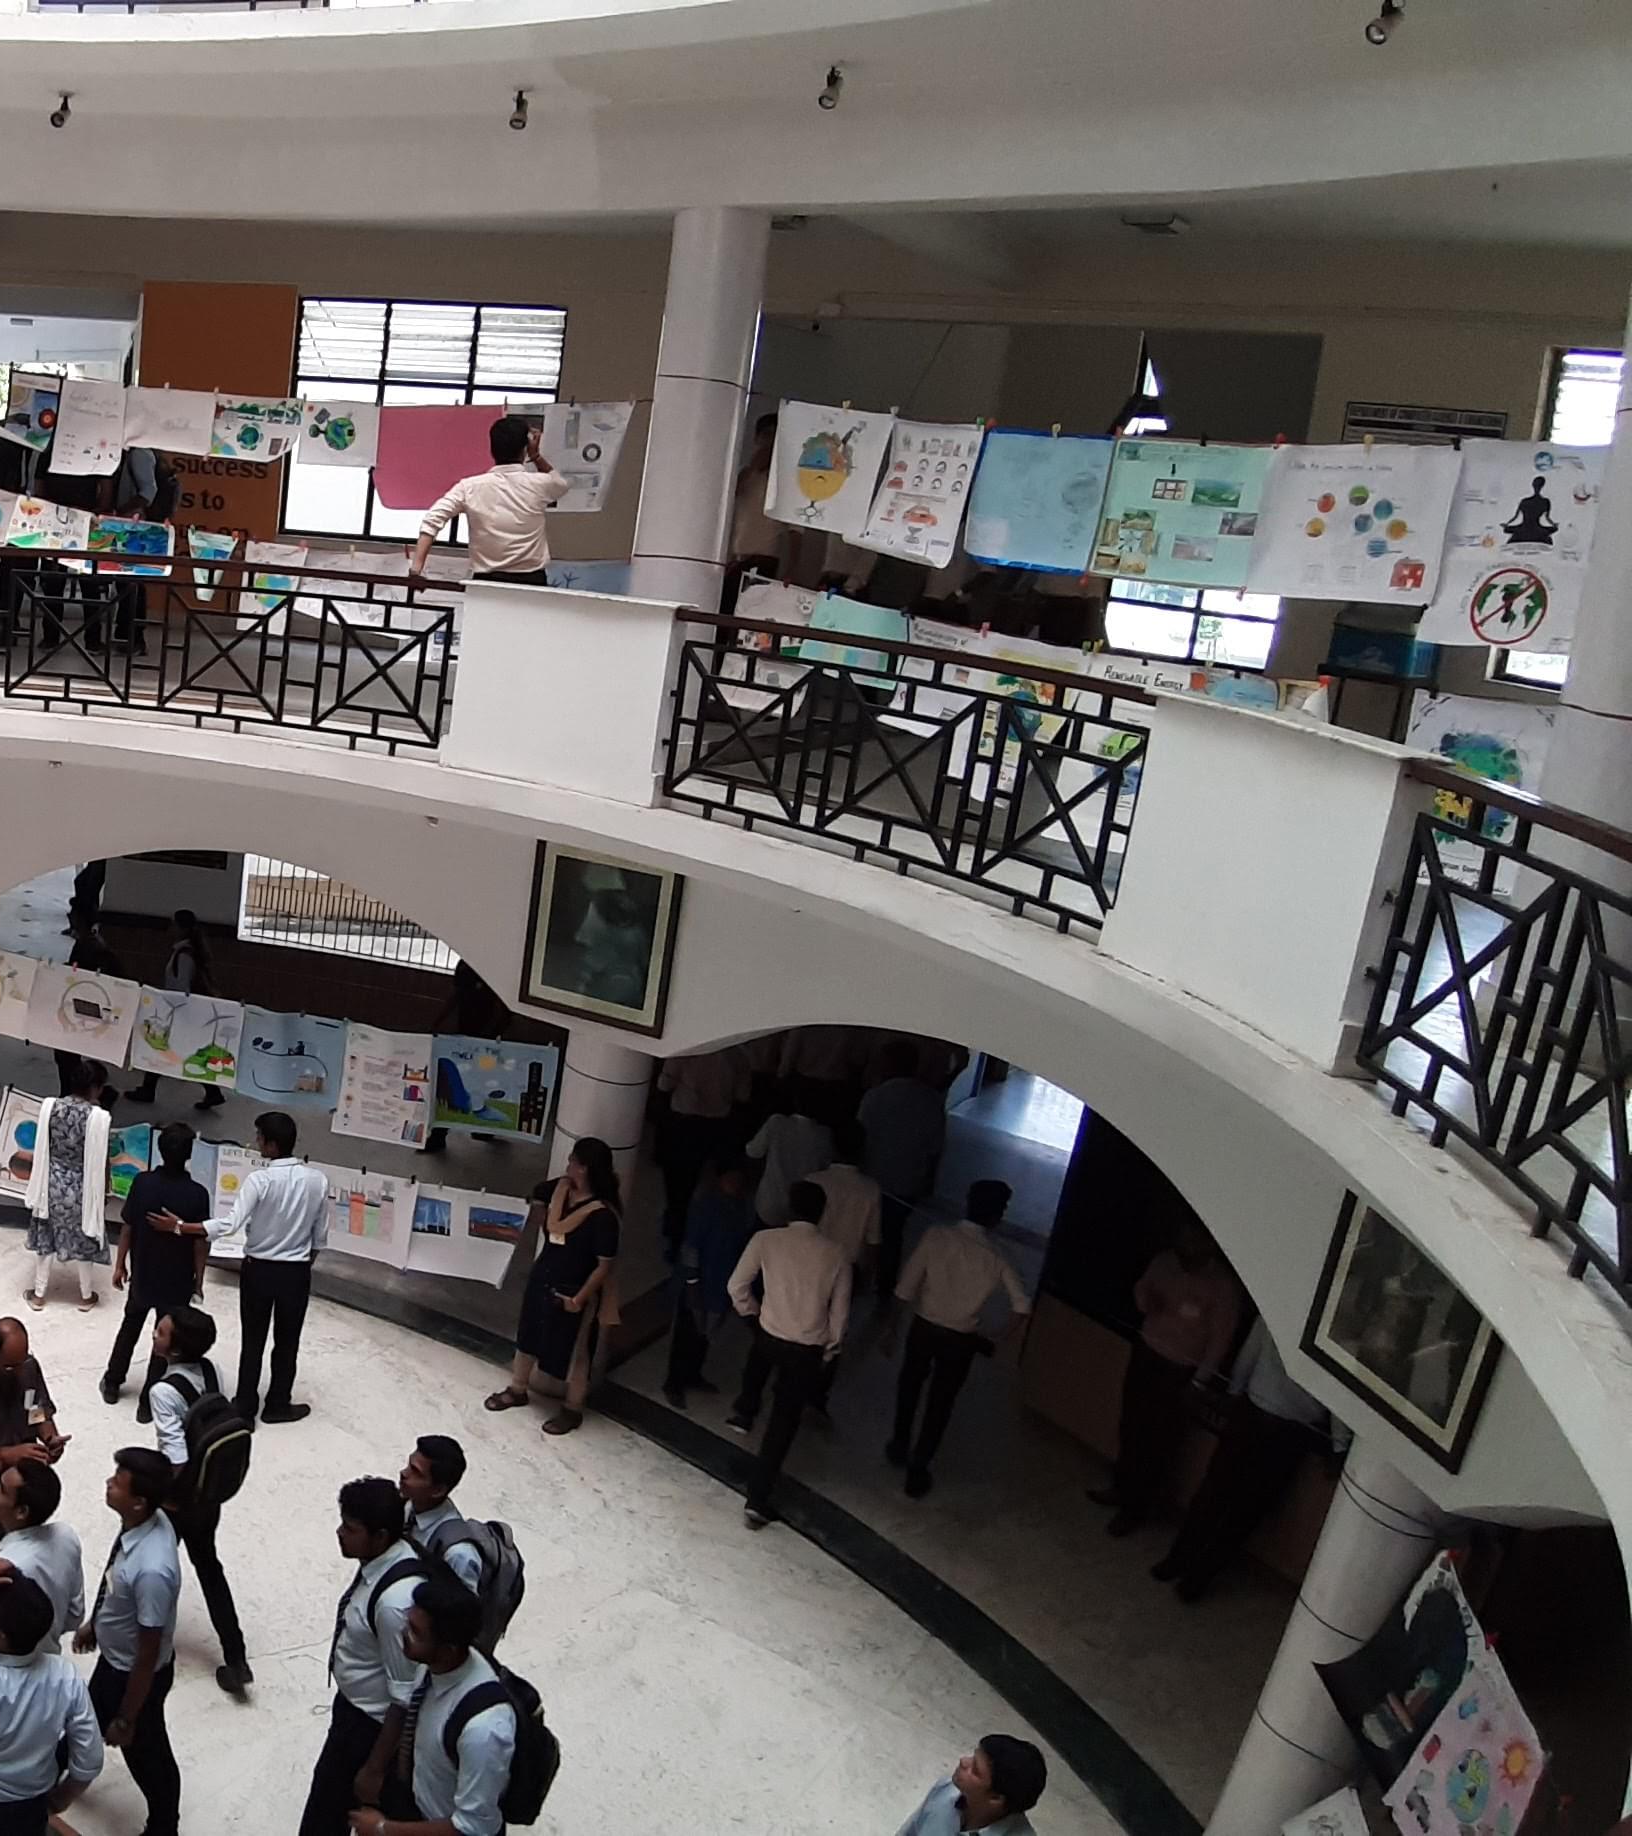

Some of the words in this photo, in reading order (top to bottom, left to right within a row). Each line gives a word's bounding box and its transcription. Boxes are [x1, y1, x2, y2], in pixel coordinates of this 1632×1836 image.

[172, 457, 268, 479] success
[200, 488, 225, 511] to
[1104, 664, 1149, 685] RENEWABLE
[1154, 672, 1184, 691] ENERGY
